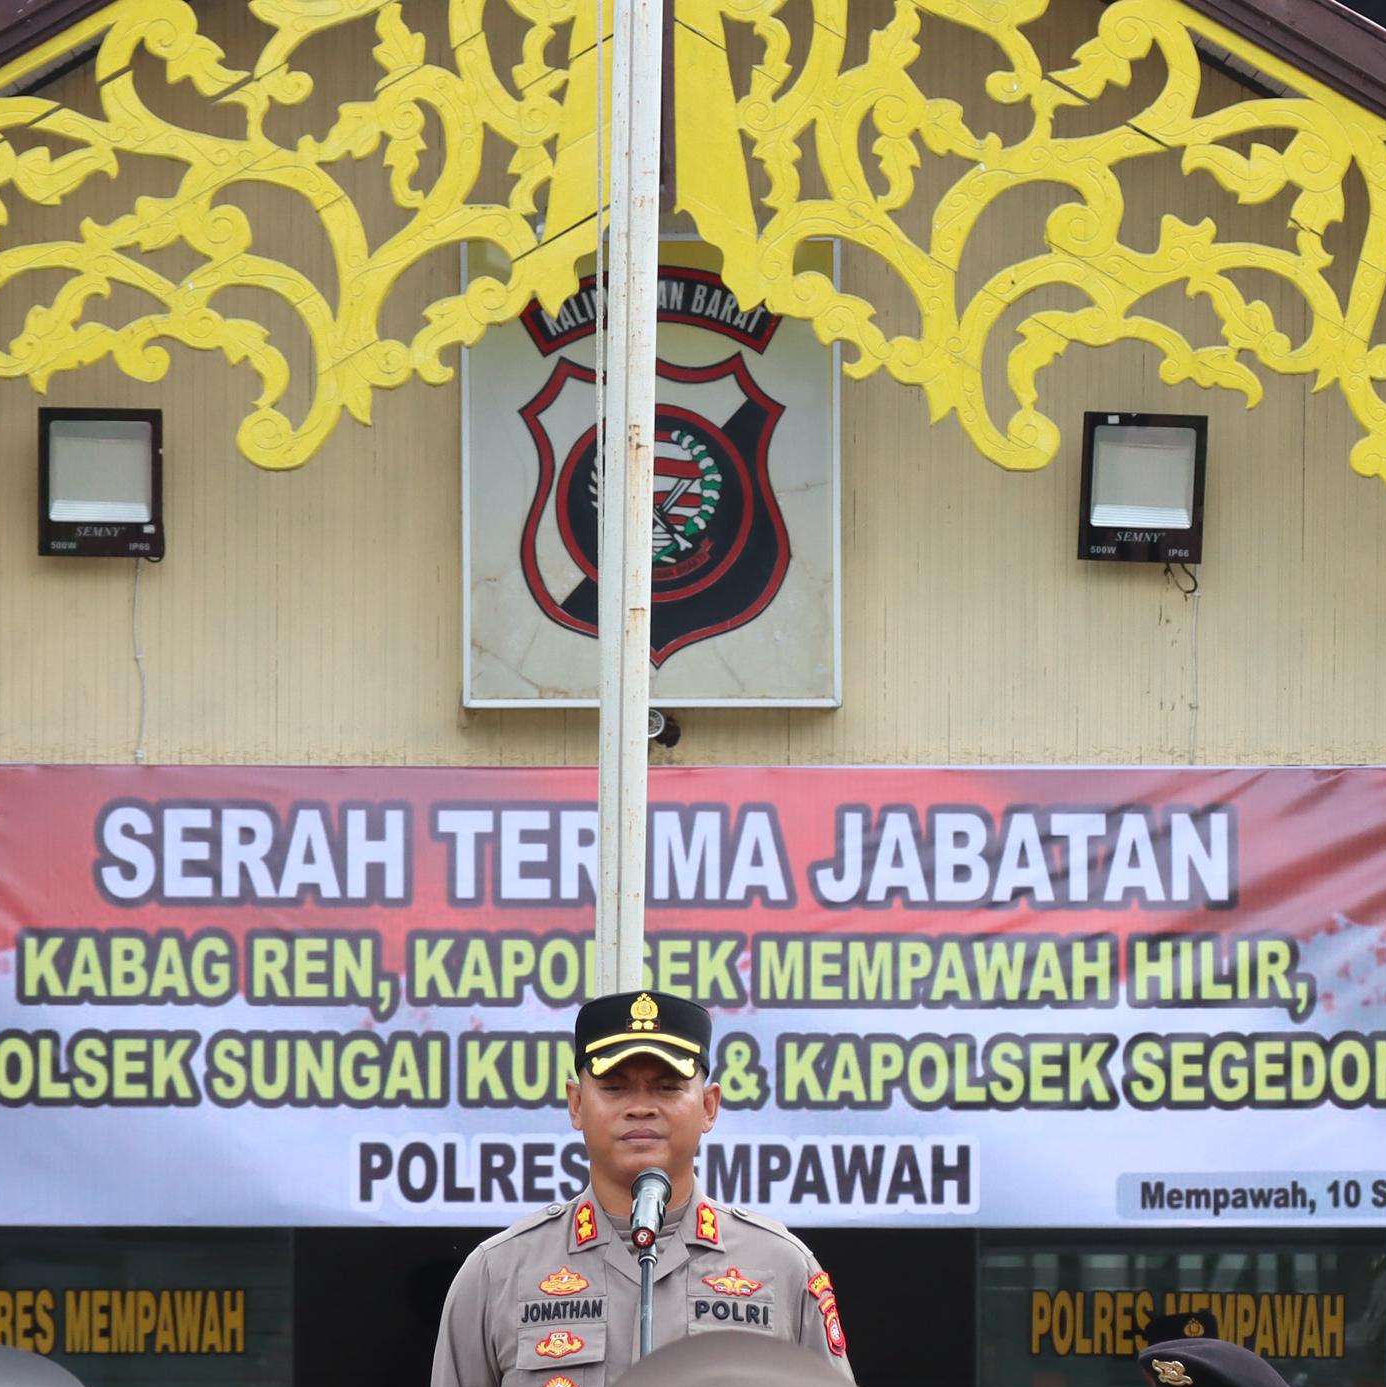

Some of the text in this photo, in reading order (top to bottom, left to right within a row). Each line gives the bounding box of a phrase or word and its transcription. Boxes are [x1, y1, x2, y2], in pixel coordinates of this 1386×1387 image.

[1090, 545, 1190, 558] 500W IP66
[1115, 531, 1160, 543] SEMNY
[99, 808, 1229, 903] SERAH TERMA JABATAN
[24, 936, 231, 998] KABAG
[253, 937, 392, 1011] REN,
[760, 940, 1113, 1002] MEMPAWAH
[1134, 940, 1309, 1014] HILIR,
[212, 1038, 442, 1101] SUNGAI
[720, 1040, 762, 1102] &
[784, 1041, 1111, 1103] KAPOLSEK
[359, 1141, 971, 1205] POLRES MPAWAH
[1139, 1181, 1317, 1216] Mempawah,
[1327, 1180, 1361, 1208] 10
[65, 1289, 245, 1354] MEMPAWAH
[521, 1299, 603, 1324] JONATHAN
[694, 1300, 769, 1326] POLRI
[1031, 1289, 1344, 1358] POLRES MPAWAH
